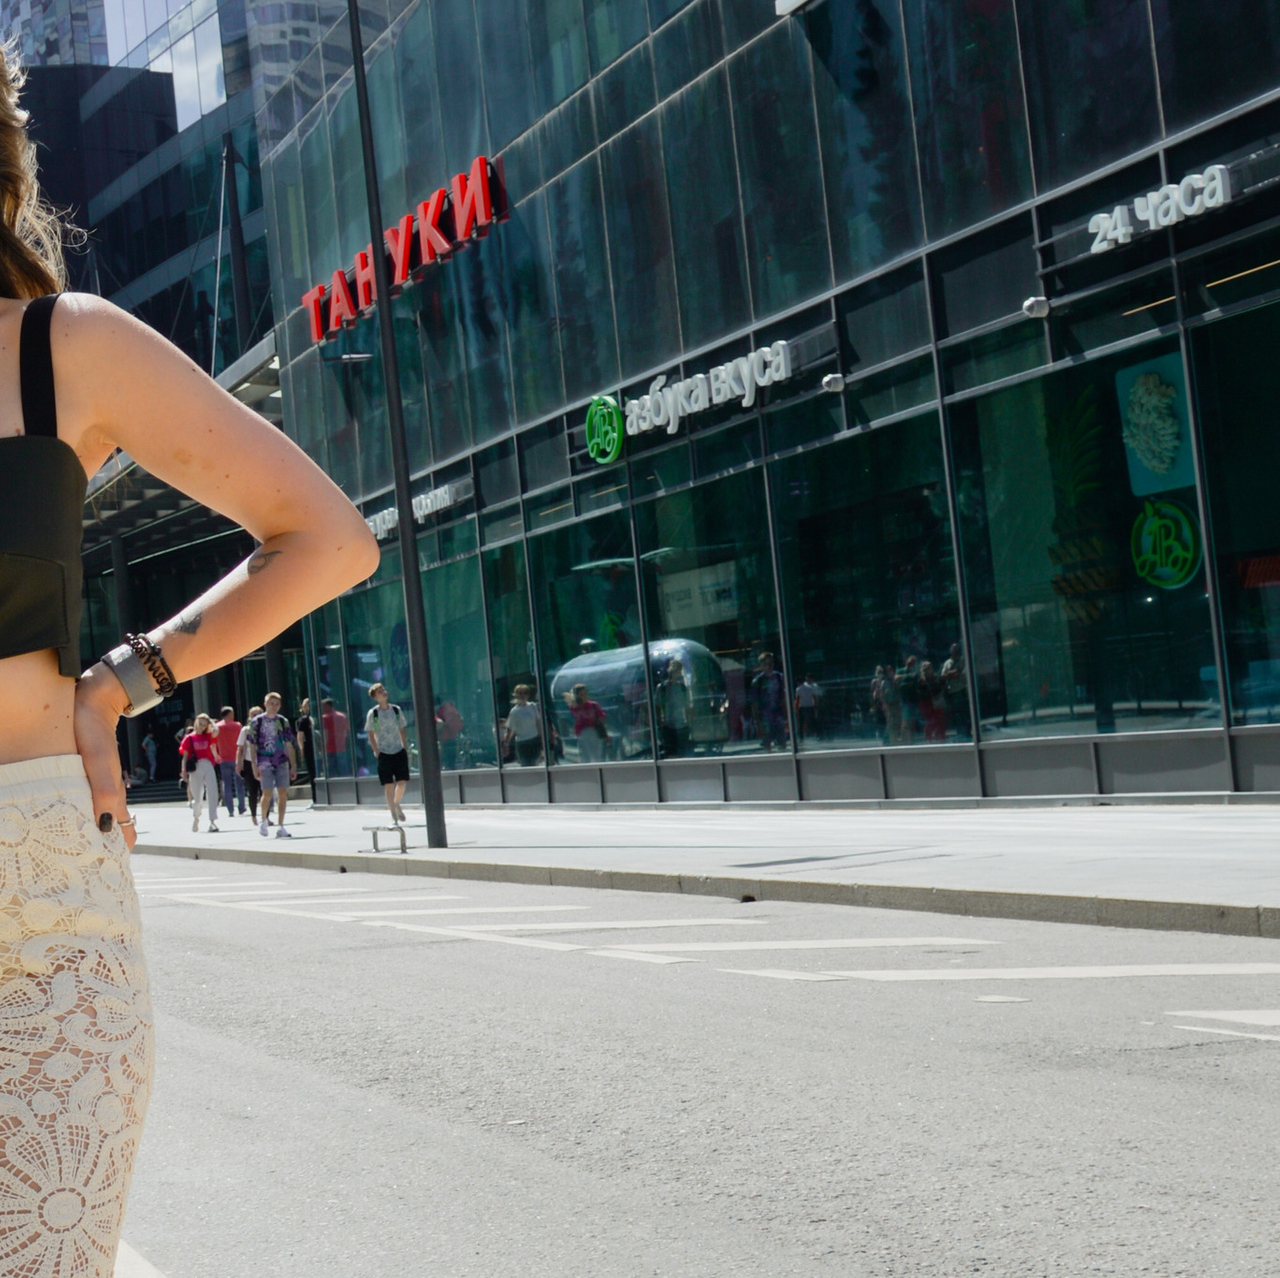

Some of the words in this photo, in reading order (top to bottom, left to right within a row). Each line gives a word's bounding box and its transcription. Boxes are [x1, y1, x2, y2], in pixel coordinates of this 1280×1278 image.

[1088, 213, 1133, 254] 24
[1134, 164, 1232, 230] часа
[625, 375, 710, 435] азбука
[709, 340, 792, 408] вкуса
